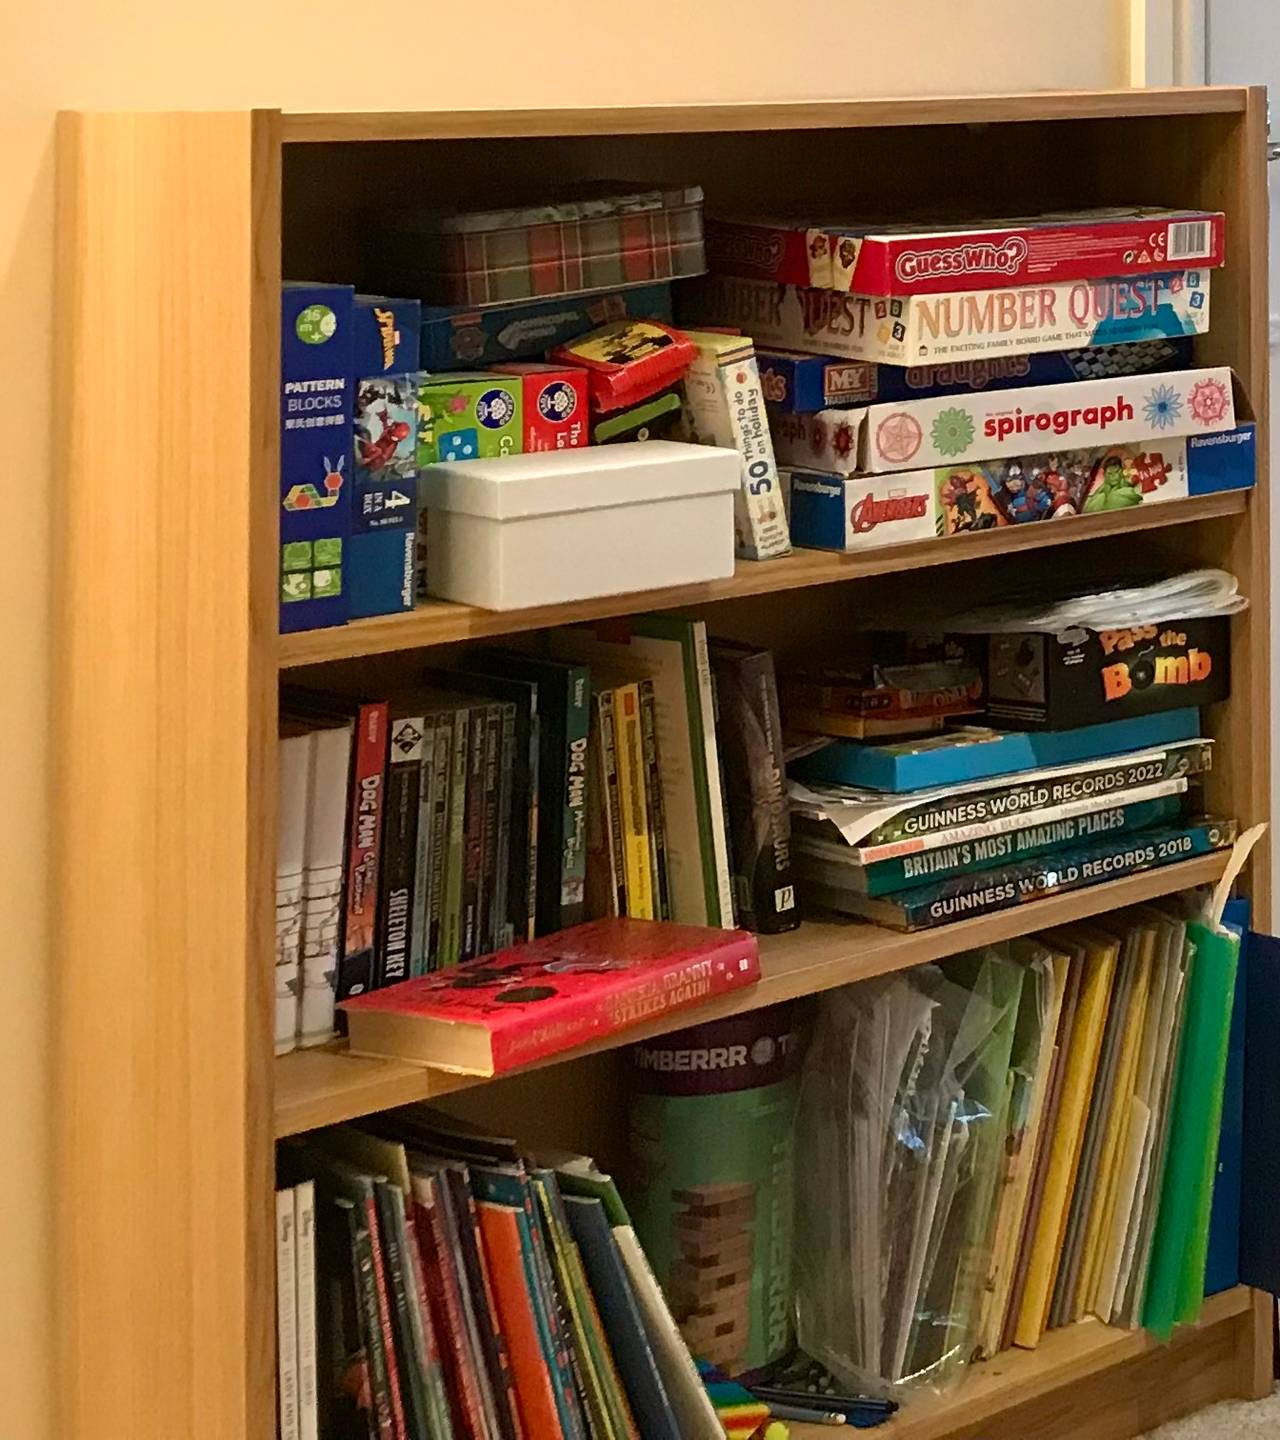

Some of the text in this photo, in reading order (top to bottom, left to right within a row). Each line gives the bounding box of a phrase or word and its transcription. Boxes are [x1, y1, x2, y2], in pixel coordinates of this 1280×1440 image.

[915, 277, 1161, 341] NUMBER QUEST
[284, 378, 346, 395] PATTERN
[287, 395, 343, 412] BLOCKS
[984, 396, 1134, 442] spirograph
[1190, 430, 1252, 449] Ravensburger
[384, 490, 411, 510] 4
[748, 460, 773, 497] 50
[400, 531, 416, 607] Ravensburger
[568, 737, 588, 774] DOG
[357, 774, 381, 849] DOG MAN
[903, 762, 1164, 834] GUINNESS WORLD RECORDS 2022
[903, 844, 971, 879] BRITAIN'S
[974, 832, 1013, 862] MOST
[1016, 817, 1075, 852] AMAZING
[1078, 807, 1125, 837] PLACES
[930, 836, 1193, 918] GUINNESS WORLD RECORDS 2018
[384, 887, 409, 979] SKELETON KEY
